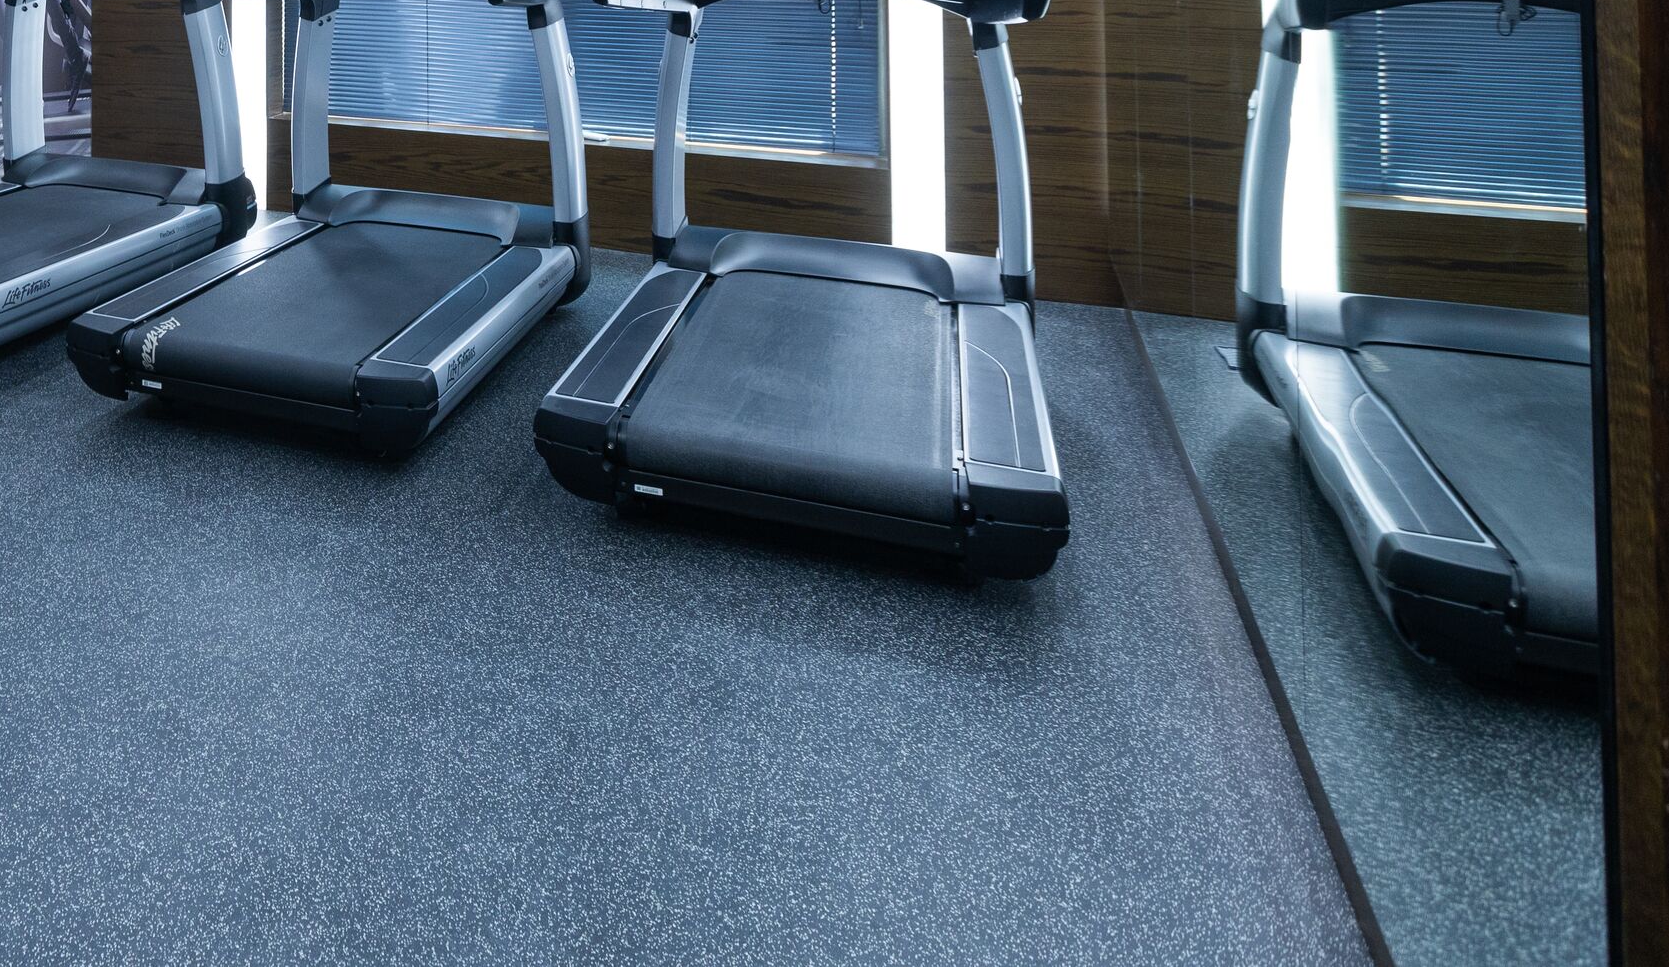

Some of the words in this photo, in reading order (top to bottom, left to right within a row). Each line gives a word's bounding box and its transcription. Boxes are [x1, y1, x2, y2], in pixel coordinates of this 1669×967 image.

[2, 287, 22, 309] Life
[21, 278, 51, 302] Fitness
[159, 316, 181, 331] Life
